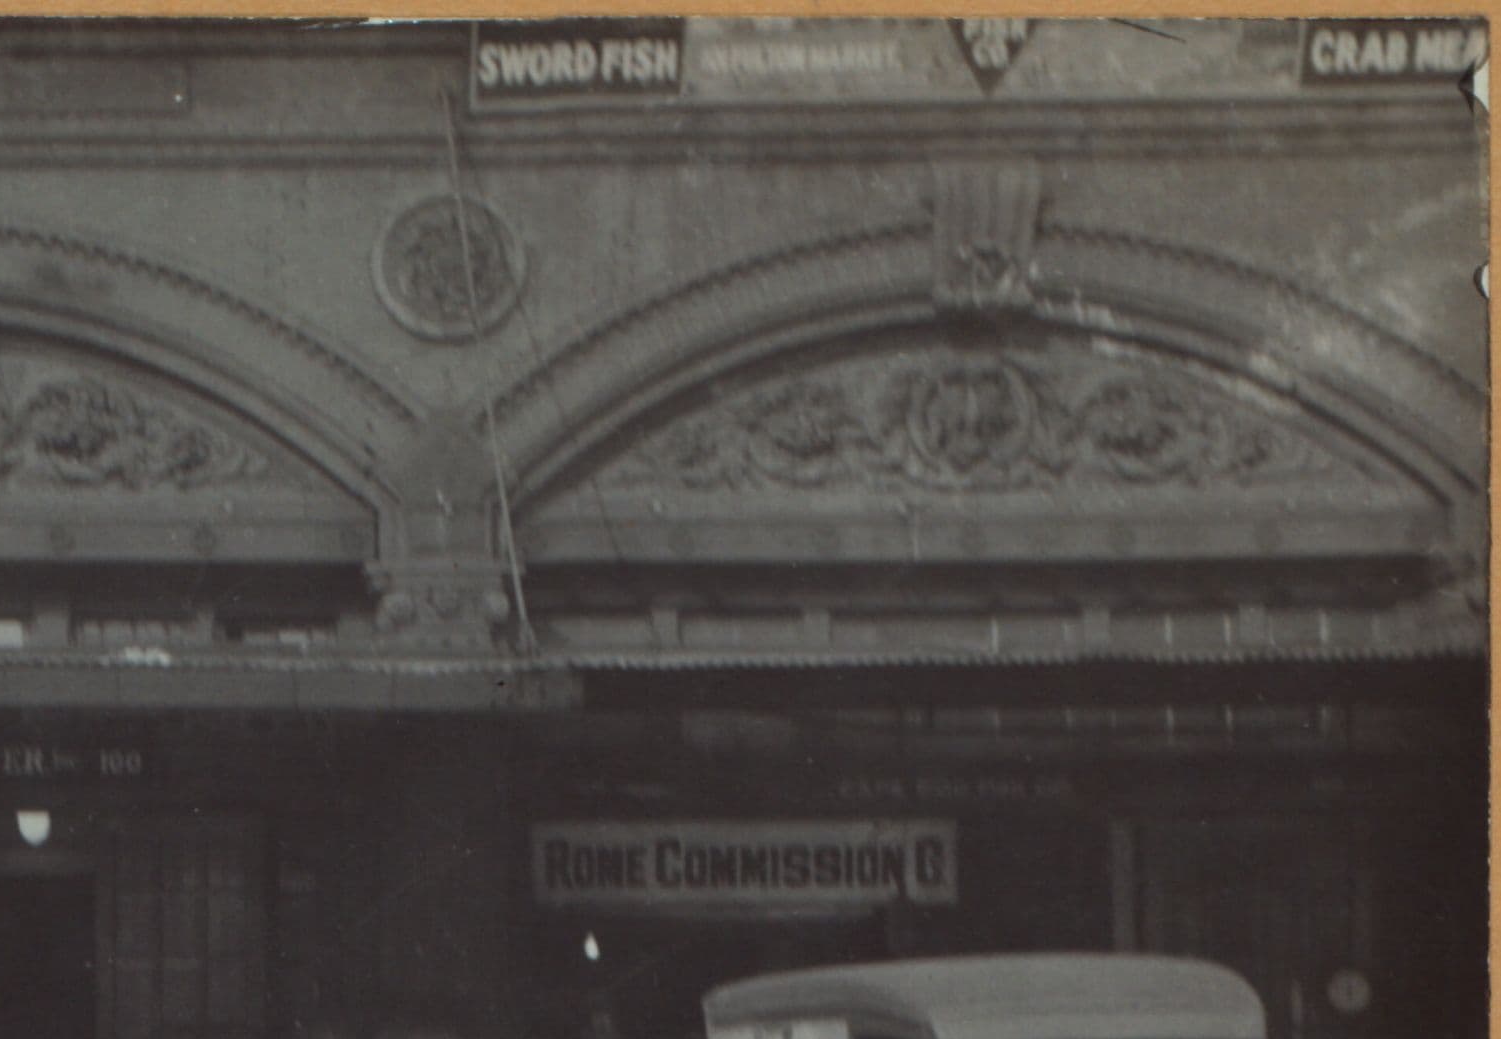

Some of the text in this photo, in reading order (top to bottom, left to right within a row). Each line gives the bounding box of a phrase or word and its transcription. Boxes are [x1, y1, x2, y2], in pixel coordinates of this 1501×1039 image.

[479, 37, 679, 87] SWORD FISH
[1311, 27, 1409, 75] CRAB
[99, 748, 142, 775] 100
[544, 837, 648, 889] ROME
[654, 837, 907, 889] COMMISSION
